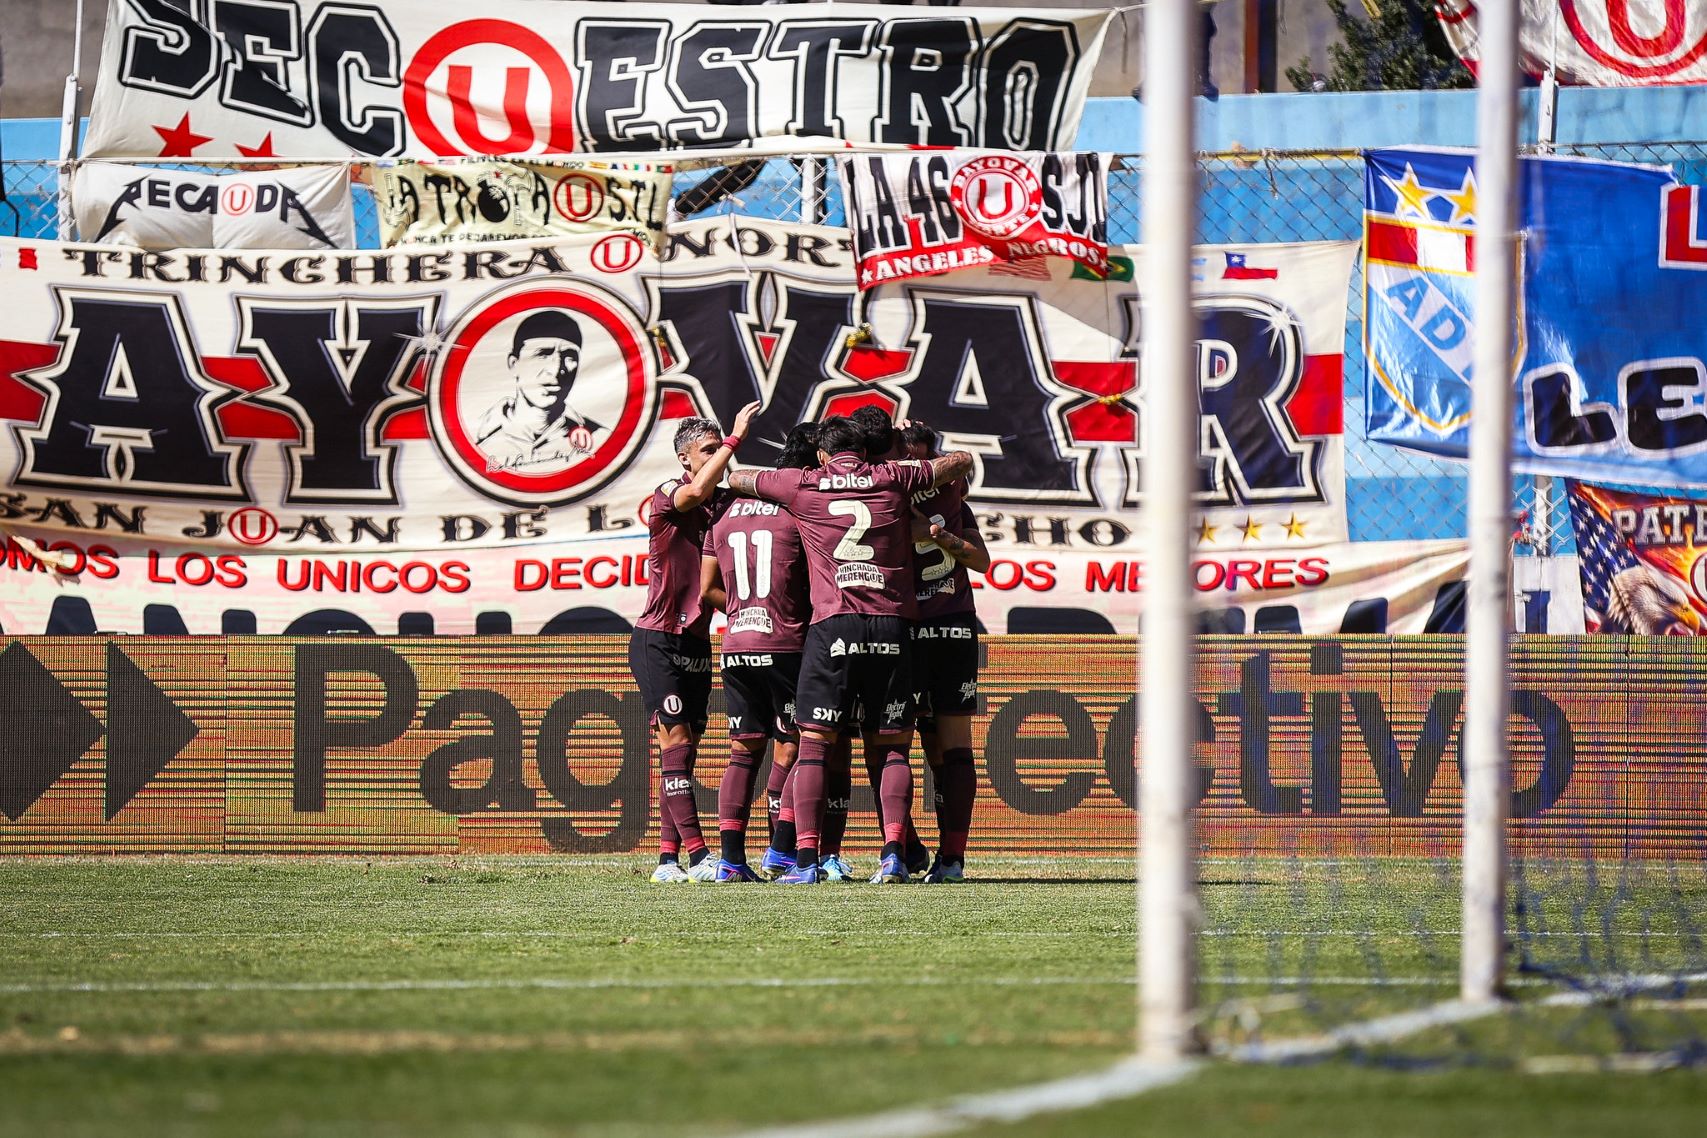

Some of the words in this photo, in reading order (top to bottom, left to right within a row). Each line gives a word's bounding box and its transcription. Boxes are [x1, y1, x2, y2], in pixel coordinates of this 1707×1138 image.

[96, 175, 340, 249] RECAUDA
[62, 246, 574, 284] TRINCHERA
[664, 227, 852, 268] NOR
[877, 245, 994, 280] ANGELES
[1008, 237, 1101, 267] NEGROS
[1387, 275, 1469, 352] AD
[833, 473, 874, 489] bitel
[440, 505, 548, 542] DE
[828, 500, 874, 561] 2
[0, 535, 120, 579] MOS
[149, 550, 248, 588] LOS
[277, 558, 472, 594] UNICOS
[971, 559, 1057, 592] OS
[1085, 557, 1330, 593] MEORES
[728, 530, 773, 601] 11
[848, 642, 900, 655] ALTOS
[918, 627, 972, 639] ALTOS
[727, 655, 774, 667] ALTOS
[812, 707, 842, 722] SKY
